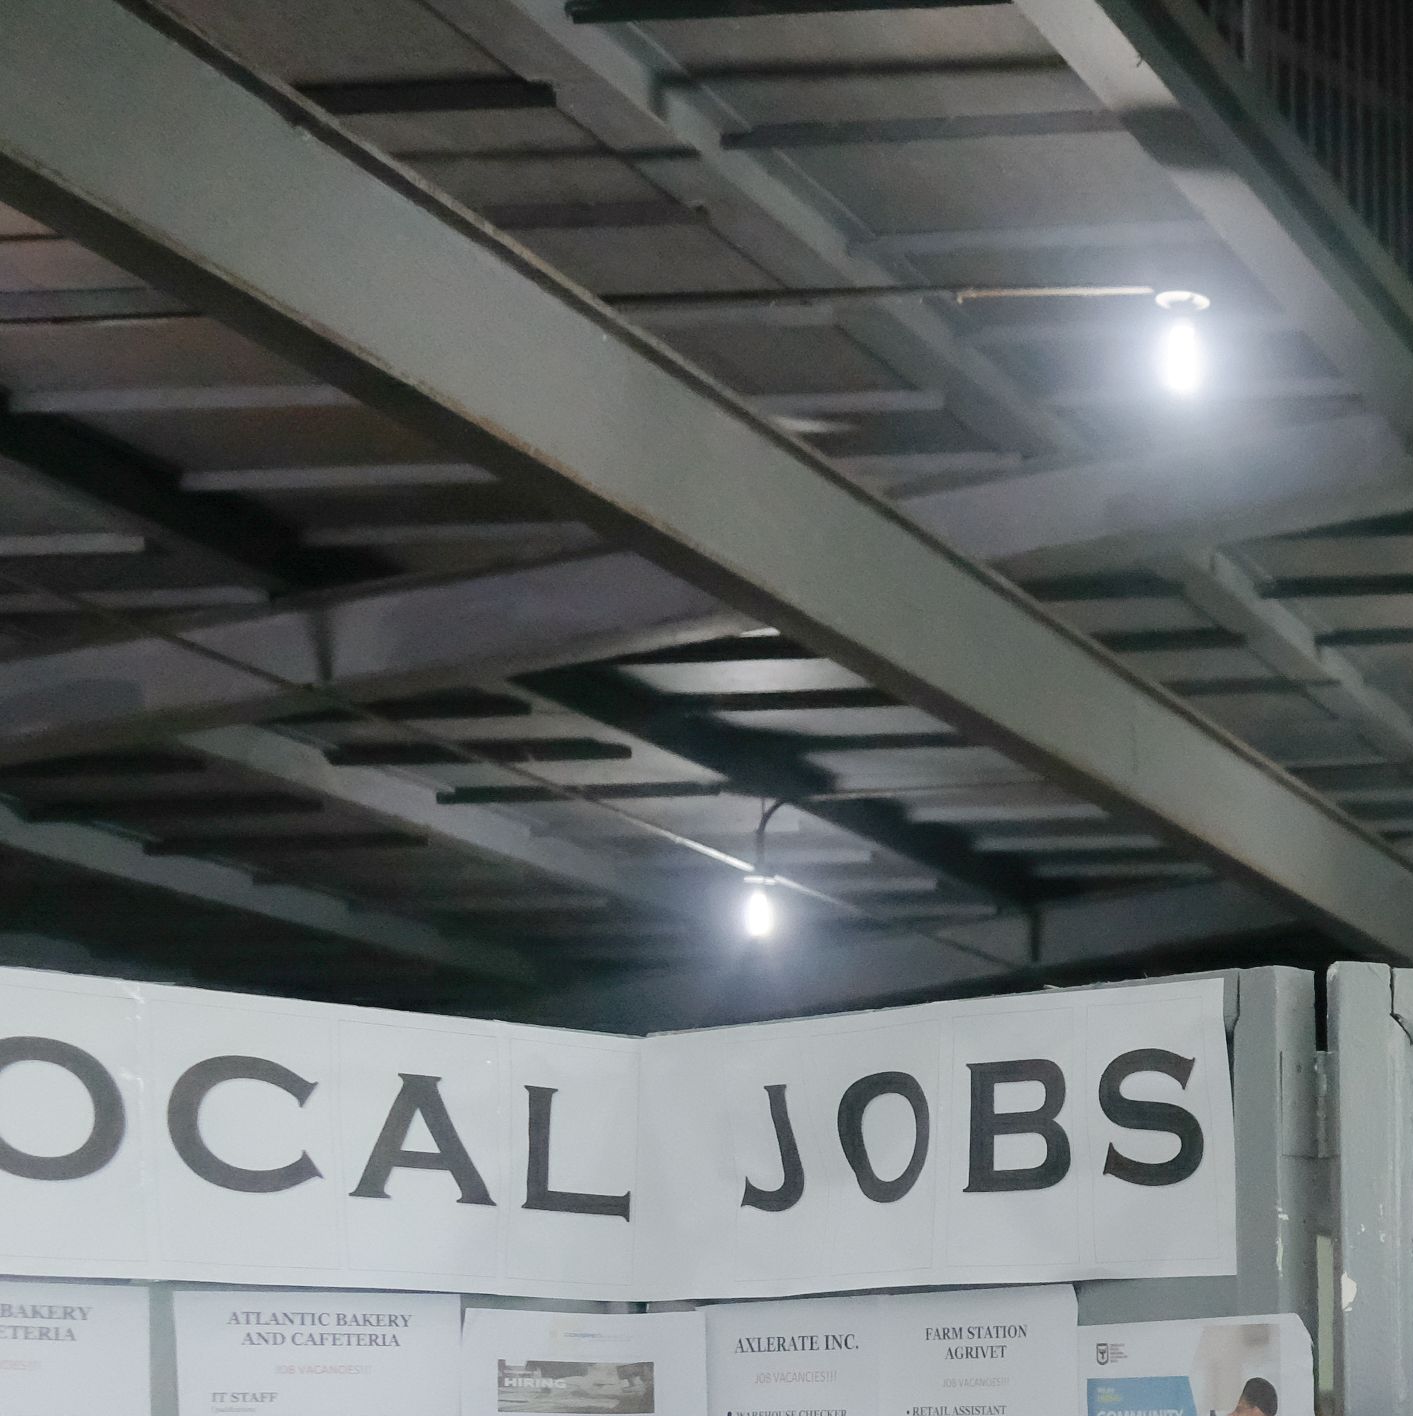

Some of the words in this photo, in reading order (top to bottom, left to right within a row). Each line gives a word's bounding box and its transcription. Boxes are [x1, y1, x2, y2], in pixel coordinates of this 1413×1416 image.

[741, 1048, 1203, 1211] JOBS
[3, 1304, 93, 1321] BAKERY
[228, 1312, 330, 1327] ATLANTIC
[336, 1313, 412, 1328] BAKERY
[242, 1332, 286, 1346] AND
[291, 1332, 400, 1347] CAFETERIA
[926, 1327, 962, 1340] FARM
[967, 1325, 1027, 1339] STATION
[735, 1336, 819, 1353] AXLERATE
[825, 1334, 859, 1350] INC.
[945, 1345, 1007, 1359] AGRIVET
